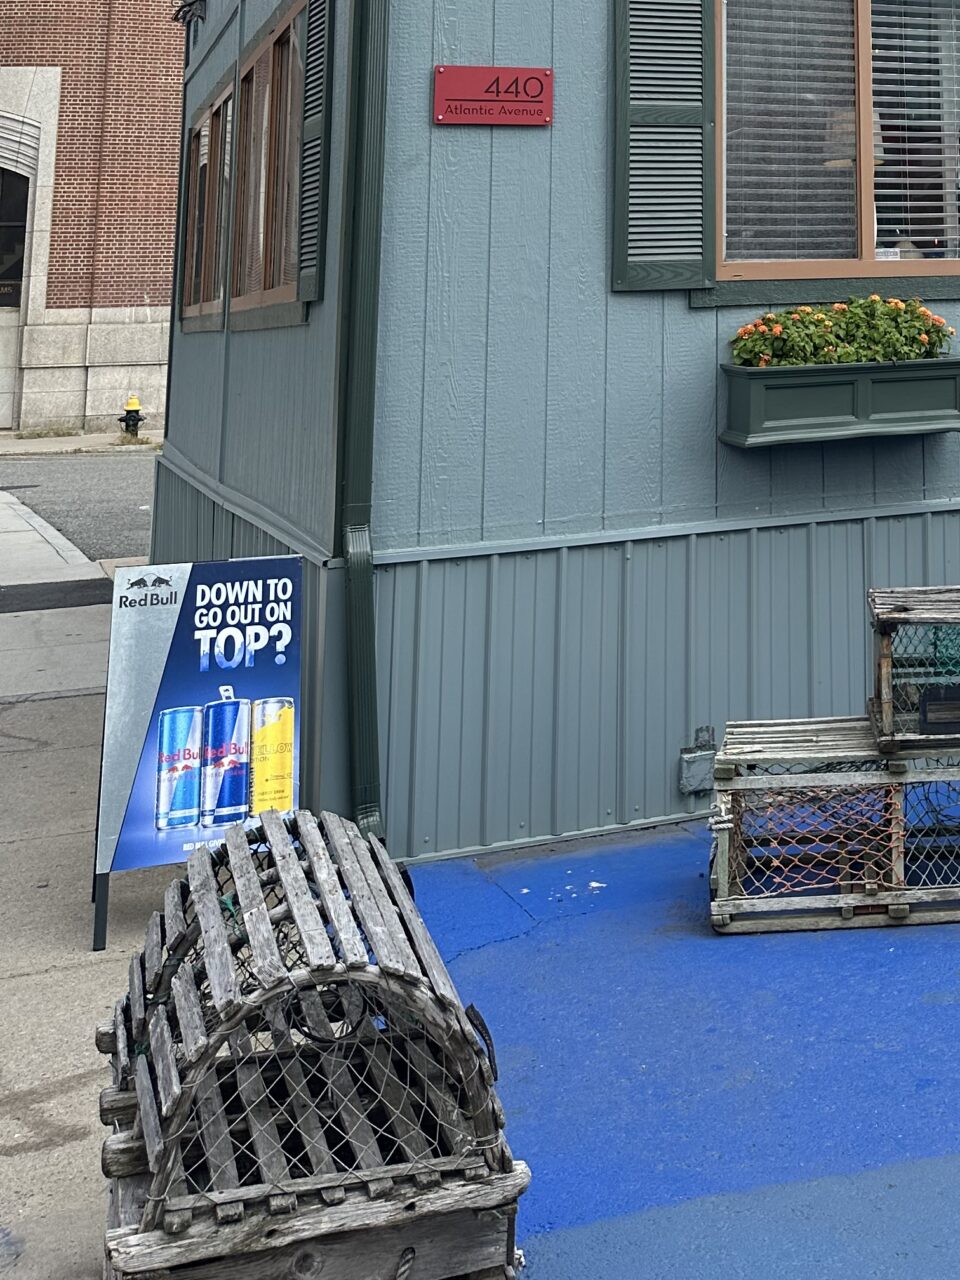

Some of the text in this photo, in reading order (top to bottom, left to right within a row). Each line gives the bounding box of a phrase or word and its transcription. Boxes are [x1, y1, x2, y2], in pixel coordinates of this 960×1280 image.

[484, 76, 544, 99] 440
[445, 104, 544, 117] Atlantic Avenue
[119, 591, 177, 609] Red Bull
[196, 577, 293, 607] DOWN TO
[194, 601, 292, 628] GO OUT ON
[194, 622, 292, 672] TOP?
